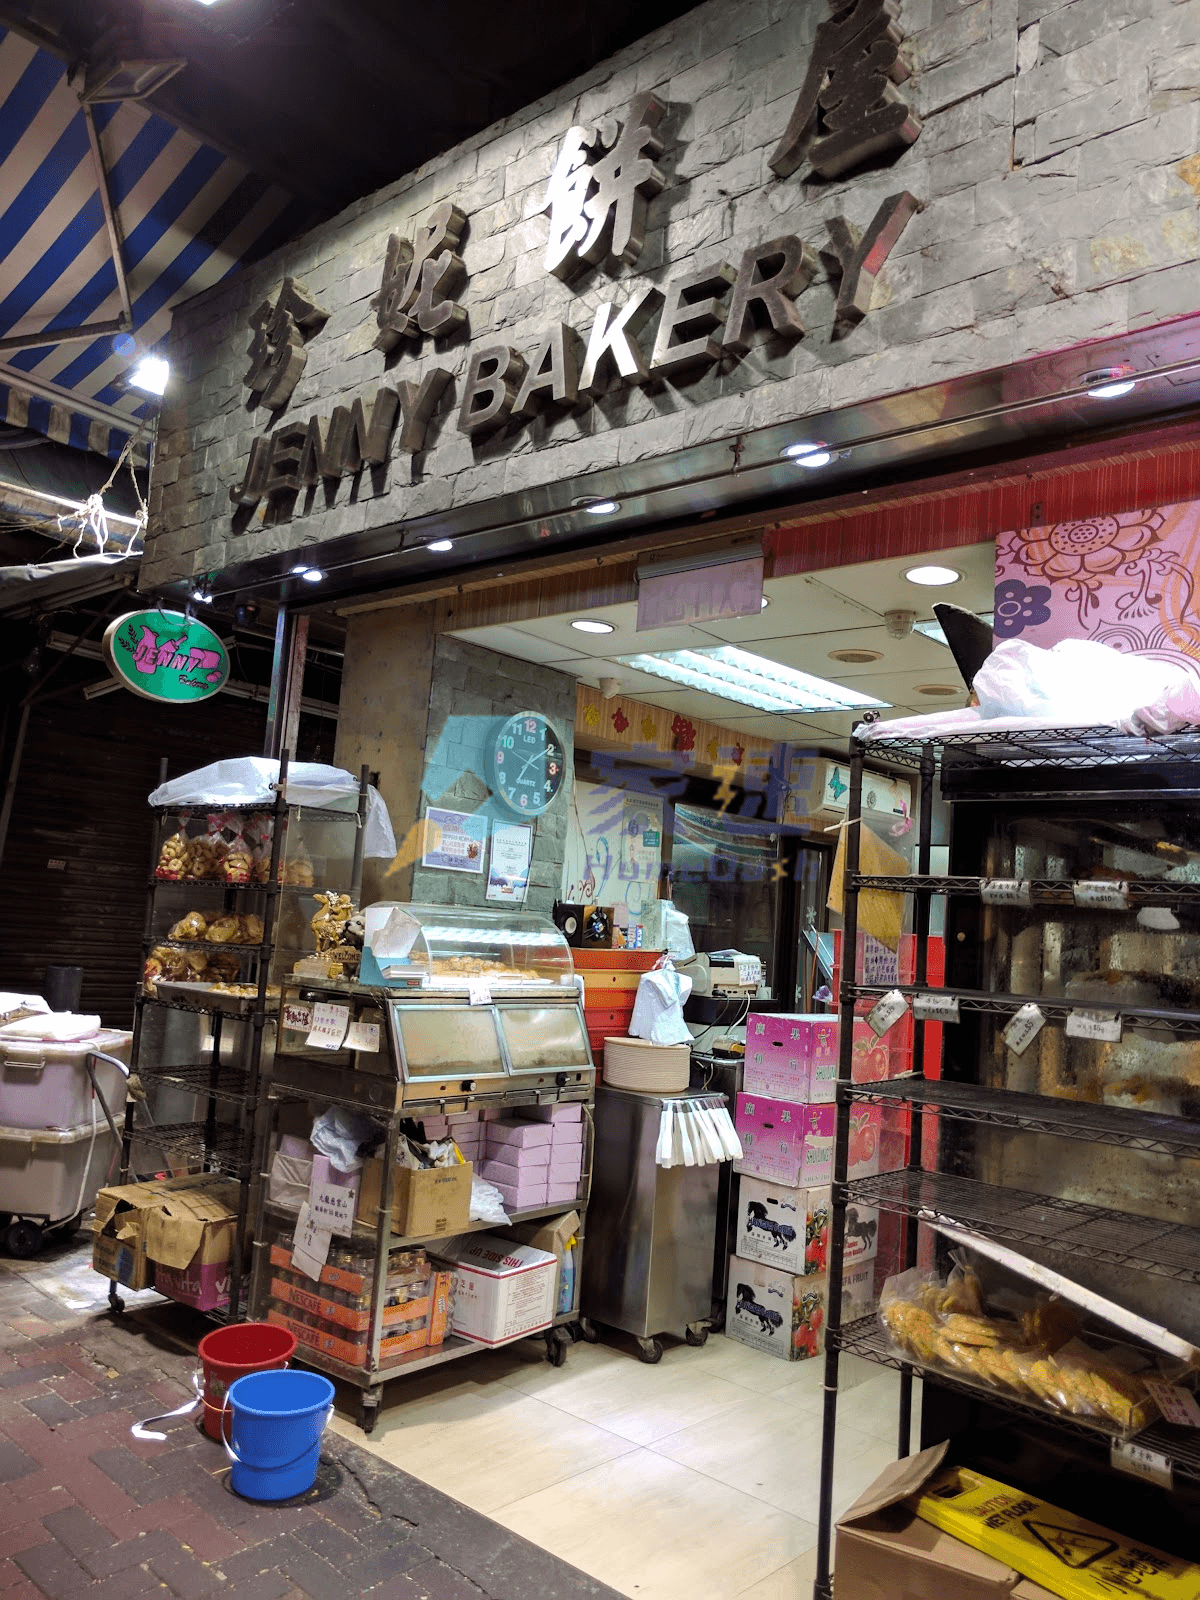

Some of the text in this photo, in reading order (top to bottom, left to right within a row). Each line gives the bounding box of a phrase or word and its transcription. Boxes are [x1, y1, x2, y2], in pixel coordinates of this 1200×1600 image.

[229, 191, 920, 507] JENNY BAKERY
[132, 644, 202, 673] JENNY
[511, 722, 523, 736] 11
[524, 718, 538, 734] 12
[523, 734, 536, 744] LED
[539, 726, 548, 741] 1
[501, 734, 515, 750] 10
[495, 750, 505, 764] 9
[546, 743, 556, 757] 2
[549, 761, 557, 775] 3
[498, 771, 507, 785] 8
[507, 786, 517, 800] 7
[543, 779, 552, 793] 4
[519, 793, 528, 807] 6
[532, 791, 541, 805] 5
[332, 950, 361, 962] WELCOME
[468, 1246, 525, 1268] THIS SIDE UP
[852, 1271, 869, 1284] FRUIT
[973, 1494, 1016, 1517] CAUTION
[982, 1499, 1040, 1530] WET FLOOR
